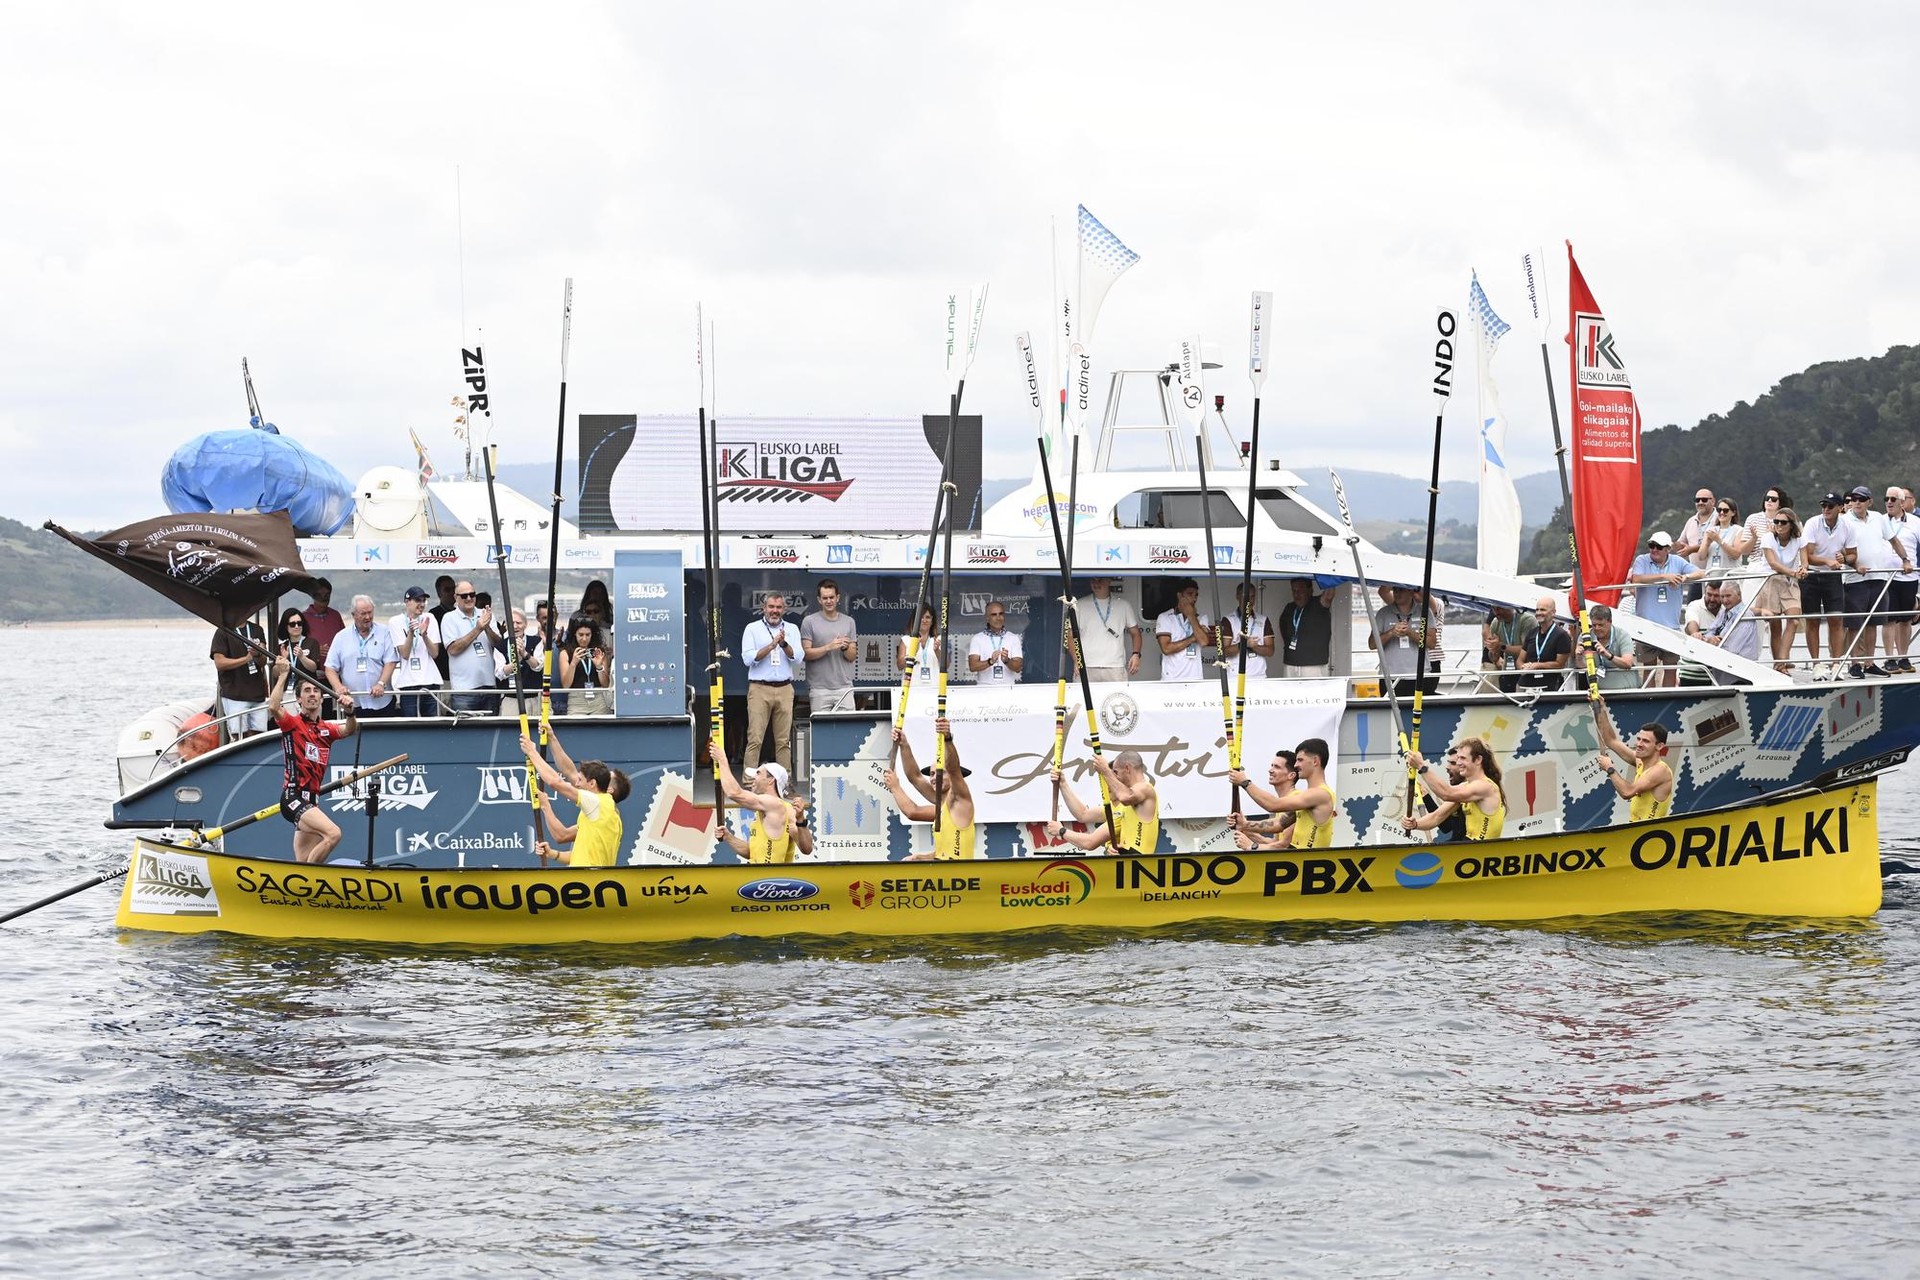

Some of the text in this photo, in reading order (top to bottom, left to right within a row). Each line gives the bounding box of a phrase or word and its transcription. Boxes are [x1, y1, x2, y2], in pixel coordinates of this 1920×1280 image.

[1433, 311, 1456, 397] INDO
[1078, 354, 1091, 410] aldinet
[1580, 371, 1604, 381] EUSKO
[1579, 401, 1632, 415] Goi-mailako
[1583, 414, 1630, 428] elikagaiak
[1584, 429, 1629, 438] Alimentos de
[760, 443, 802, 455] EUSKO
[805, 443, 843, 455] LABEL
[760, 456, 842, 482] LIGA
[430, 549, 457, 558] LIGA
[771, 548, 797, 558] LIGA
[981, 548, 1007, 558] LIGA
[1163, 550, 1189, 559] LIGA
[1568, 533, 1577, 562] SAGARDI
[869, 598, 918, 610] CaixaBan
[1215, 625, 1223, 656] SAGARDI
[1418, 617, 1426, 648] SAGARDI
[1073, 637, 1083, 669] SAGARDI
[399, 764, 428, 775] LABEL
[434, 832, 524, 850] CaixaBank
[820, 840, 882, 849] Traiñeiras
[1630, 806, 1850, 872] ORIALKI
[158, 859, 178, 870] EUSKO
[180, 862, 200, 874] LABEL
[1454, 846, 1607, 880] ORBINOX
[159, 867, 204, 888] LIGA
[1115, 855, 1246, 889] INDO
[1263, 857, 1377, 897] PBX
[235, 865, 403, 903] SAGARDI
[641, 883, 708, 898] URMA
[752, 881, 804, 899] Ford
[880, 877, 981, 893] SETALDE
[1000, 881, 1071, 895] Euskadi
[259, 894, 388, 912] Euskal Sukaldariak
[420, 875, 628, 915] iraupen
[880, 894, 962, 910] GROUP
[1000, 894, 1072, 908] LowCost
[1144, 889, 1222, 902] DELANCHY
[730, 902, 830, 913] EASO MOTOR
